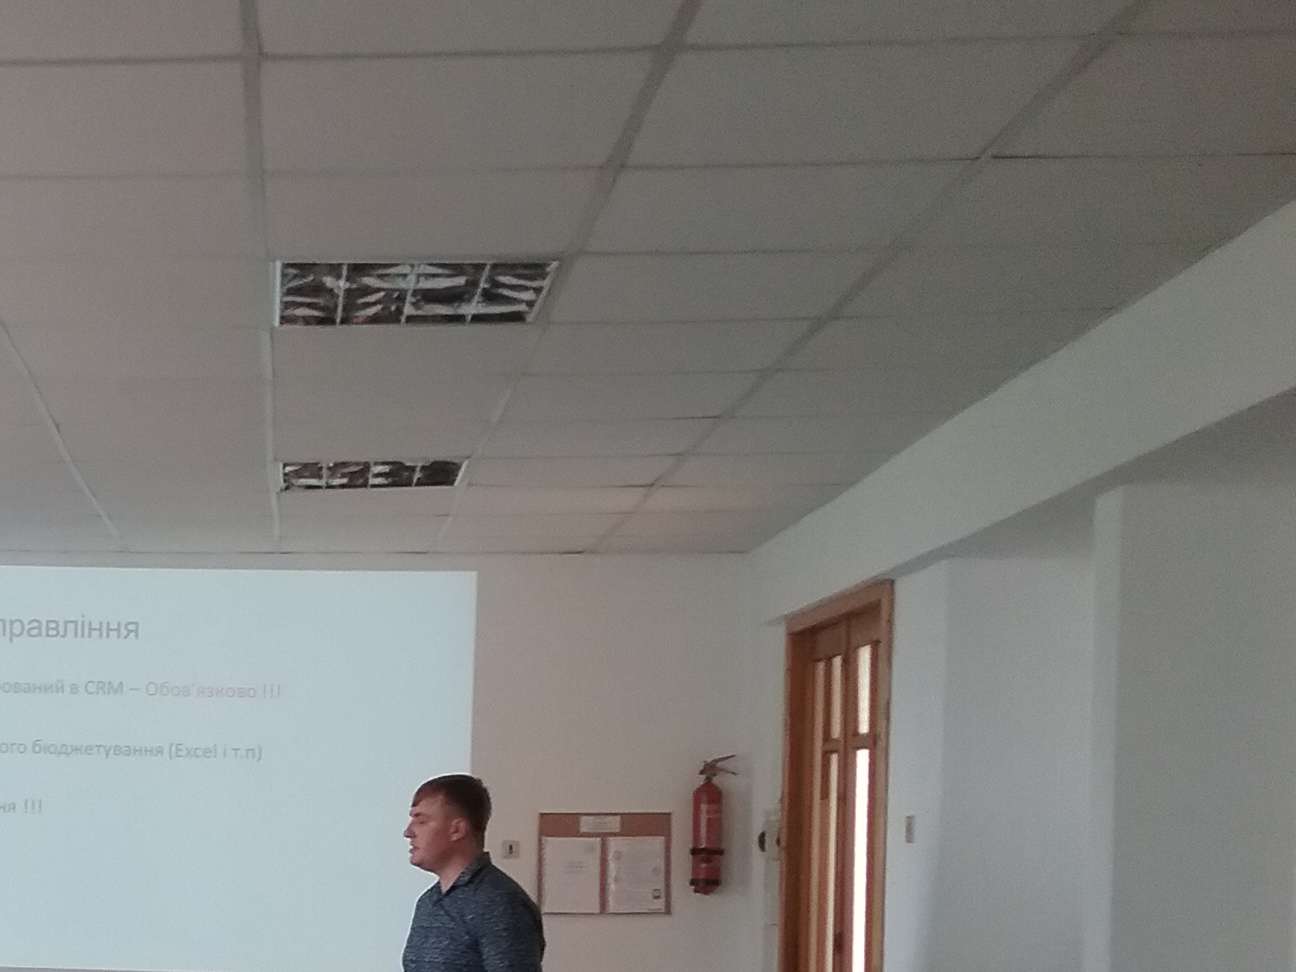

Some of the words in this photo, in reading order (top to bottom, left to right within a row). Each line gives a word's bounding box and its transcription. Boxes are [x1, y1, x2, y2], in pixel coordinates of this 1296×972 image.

[69, 682, 80, 695] в
[84, 680, 124, 696] CRM
[262, 683, 282, 699] !!!
[31, 739, 164, 760] бюджетування
[168, 742, 217, 762] (Excel
[231, 743, 263, 762] т.п)
[23, 798, 43, 815] !!!
